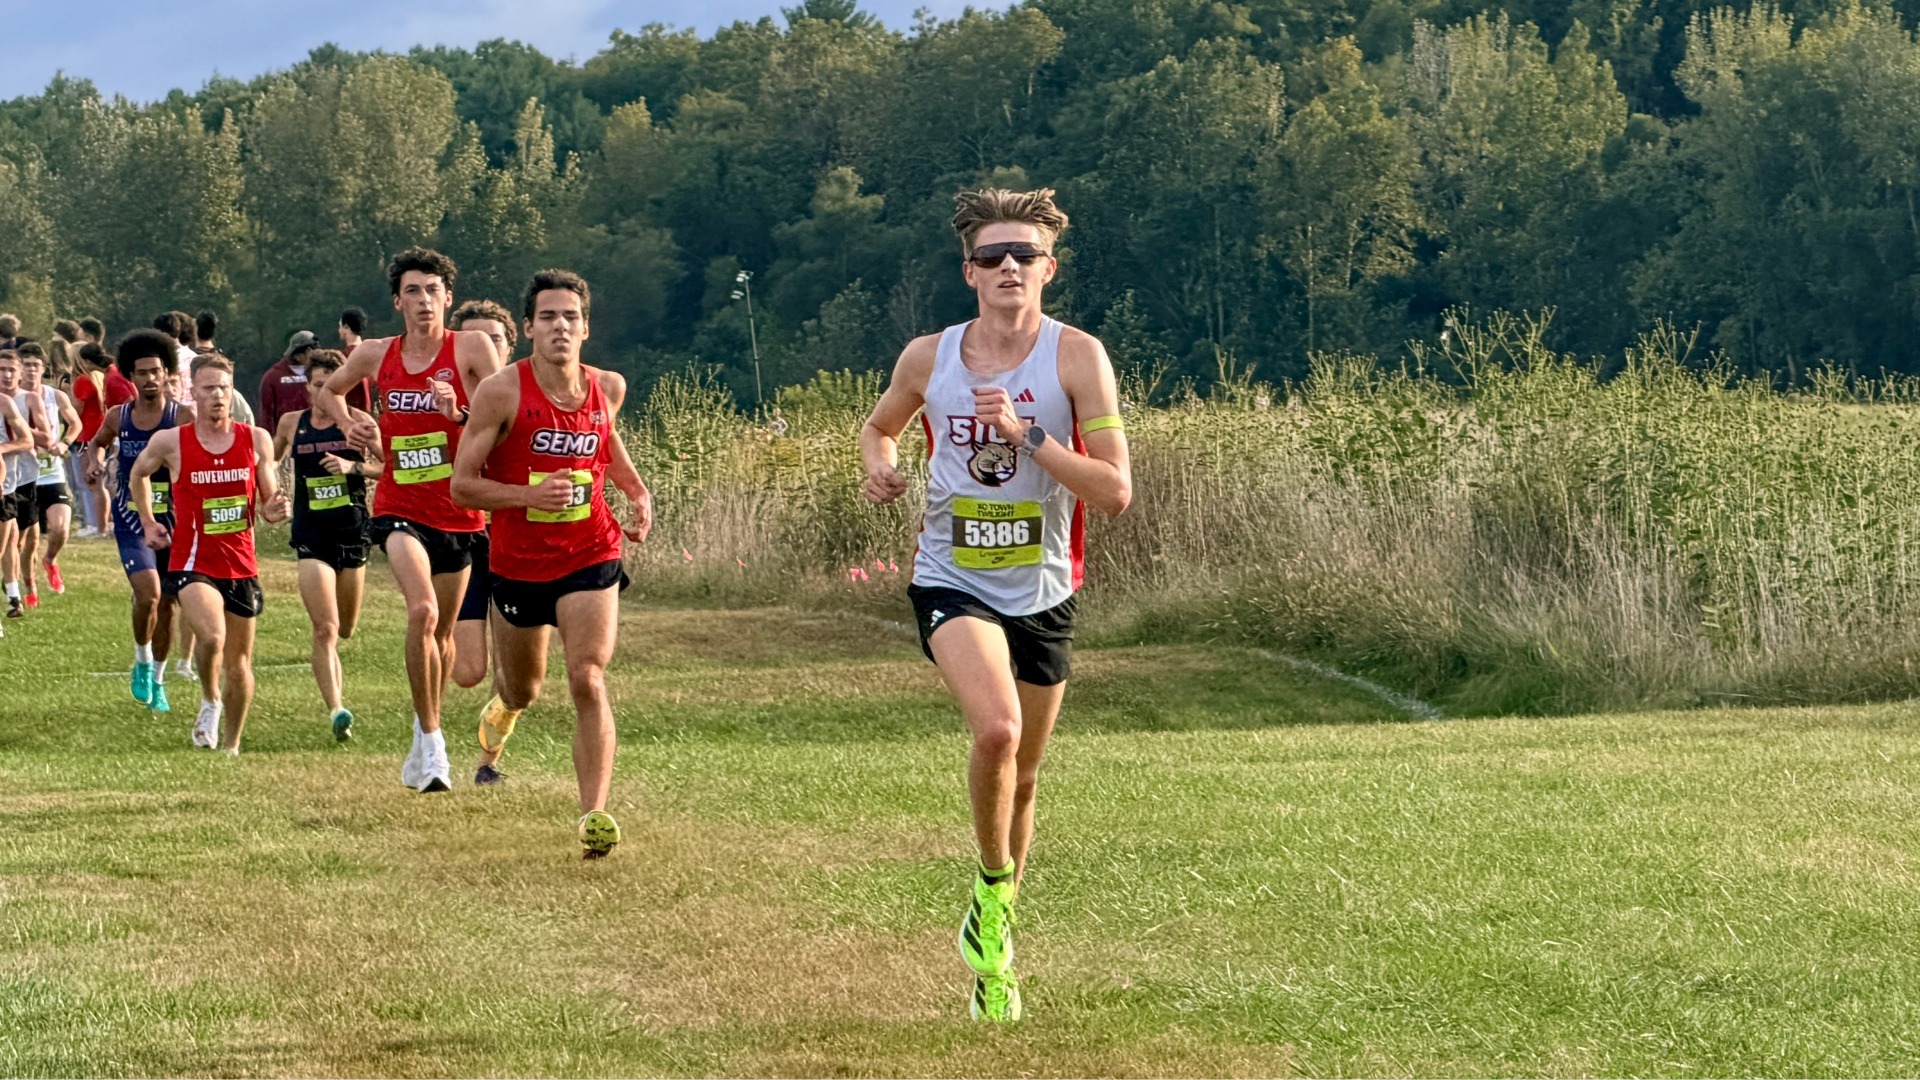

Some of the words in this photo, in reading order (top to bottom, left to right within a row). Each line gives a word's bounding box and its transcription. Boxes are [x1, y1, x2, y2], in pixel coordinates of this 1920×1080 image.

[387, 391, 437, 411] SEM
[948, 416, 1011, 446] SIU
[531, 430, 600, 456] SEMO
[398, 447, 442, 469] 5368
[190, 468, 250, 484] GOVERNORS
[314, 485, 343, 499] 5231
[211, 506, 243, 523] 5097
[964, 520, 1030, 547] 5386
